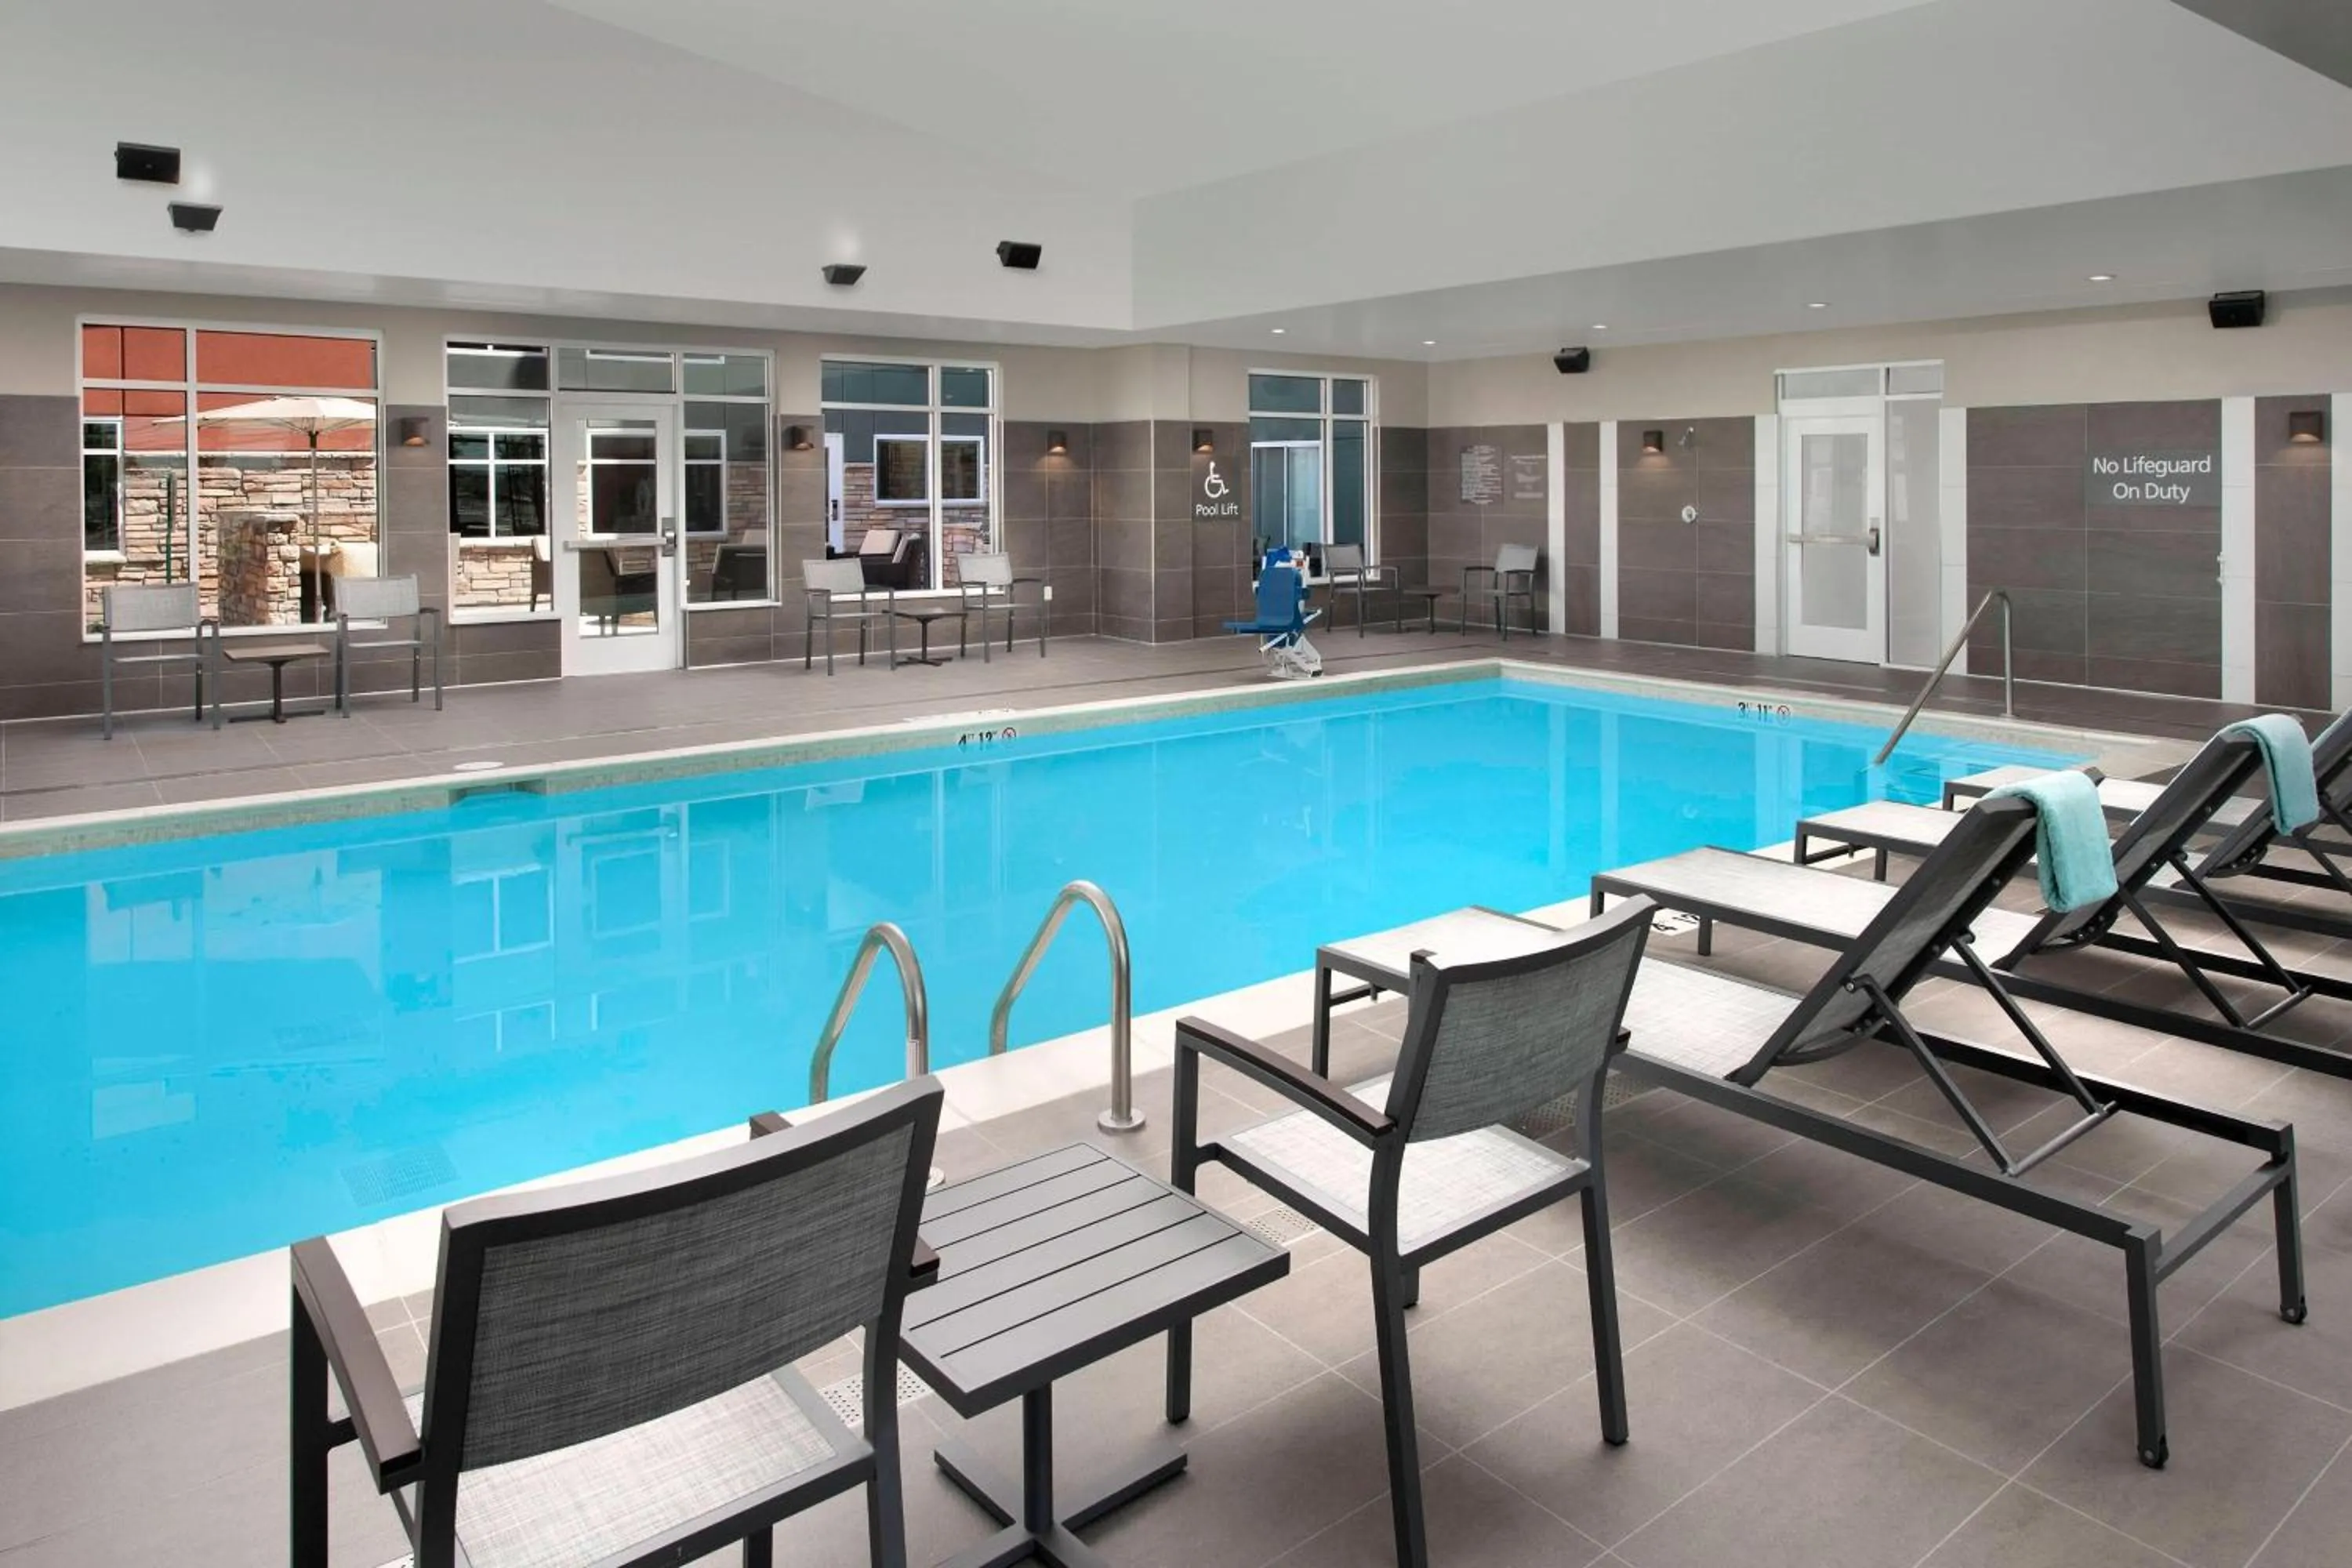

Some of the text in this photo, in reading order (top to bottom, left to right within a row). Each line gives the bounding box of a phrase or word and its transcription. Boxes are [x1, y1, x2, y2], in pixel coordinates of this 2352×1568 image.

[2093, 455, 2211, 477] No Lifeguard
[2113, 481, 2190, 504] On Duty
[1196, 502, 1239, 516] Pool Lift
